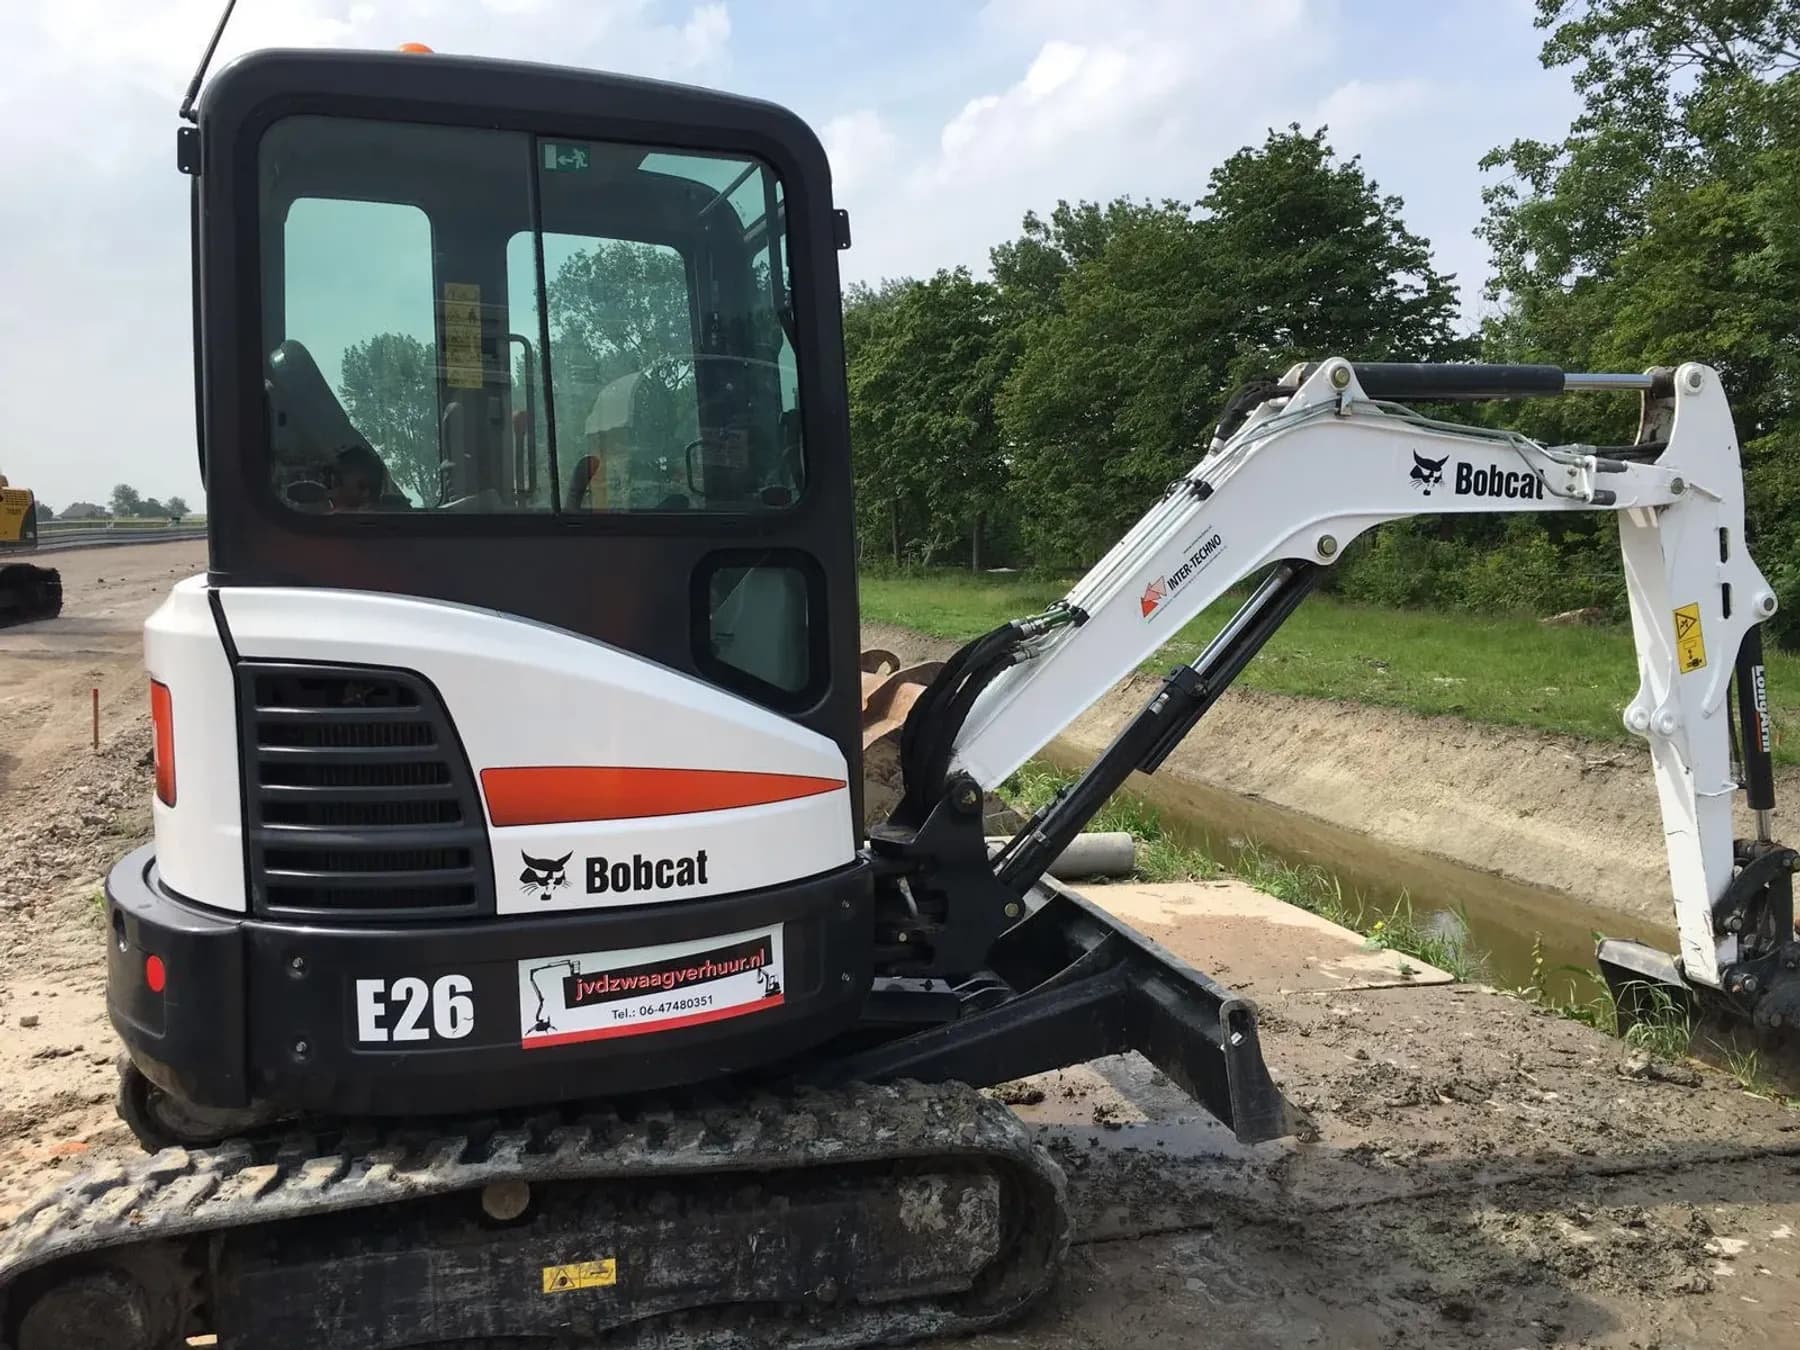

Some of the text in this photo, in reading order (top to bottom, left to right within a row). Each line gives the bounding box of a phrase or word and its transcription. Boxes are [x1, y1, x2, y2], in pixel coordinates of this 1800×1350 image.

[1455, 462, 1544, 500] Bobcat
[1167, 534, 1222, 591] INTER-TECHNO
[1754, 665, 1770, 752] LongArm
[586, 849, 708, 894] Bobcat
[576, 948, 765, 1001] jvdzwaagverhuur.nl
[356, 974, 474, 1042] E26
[612, 995, 713, 1020] Tel.: 06-47480351
